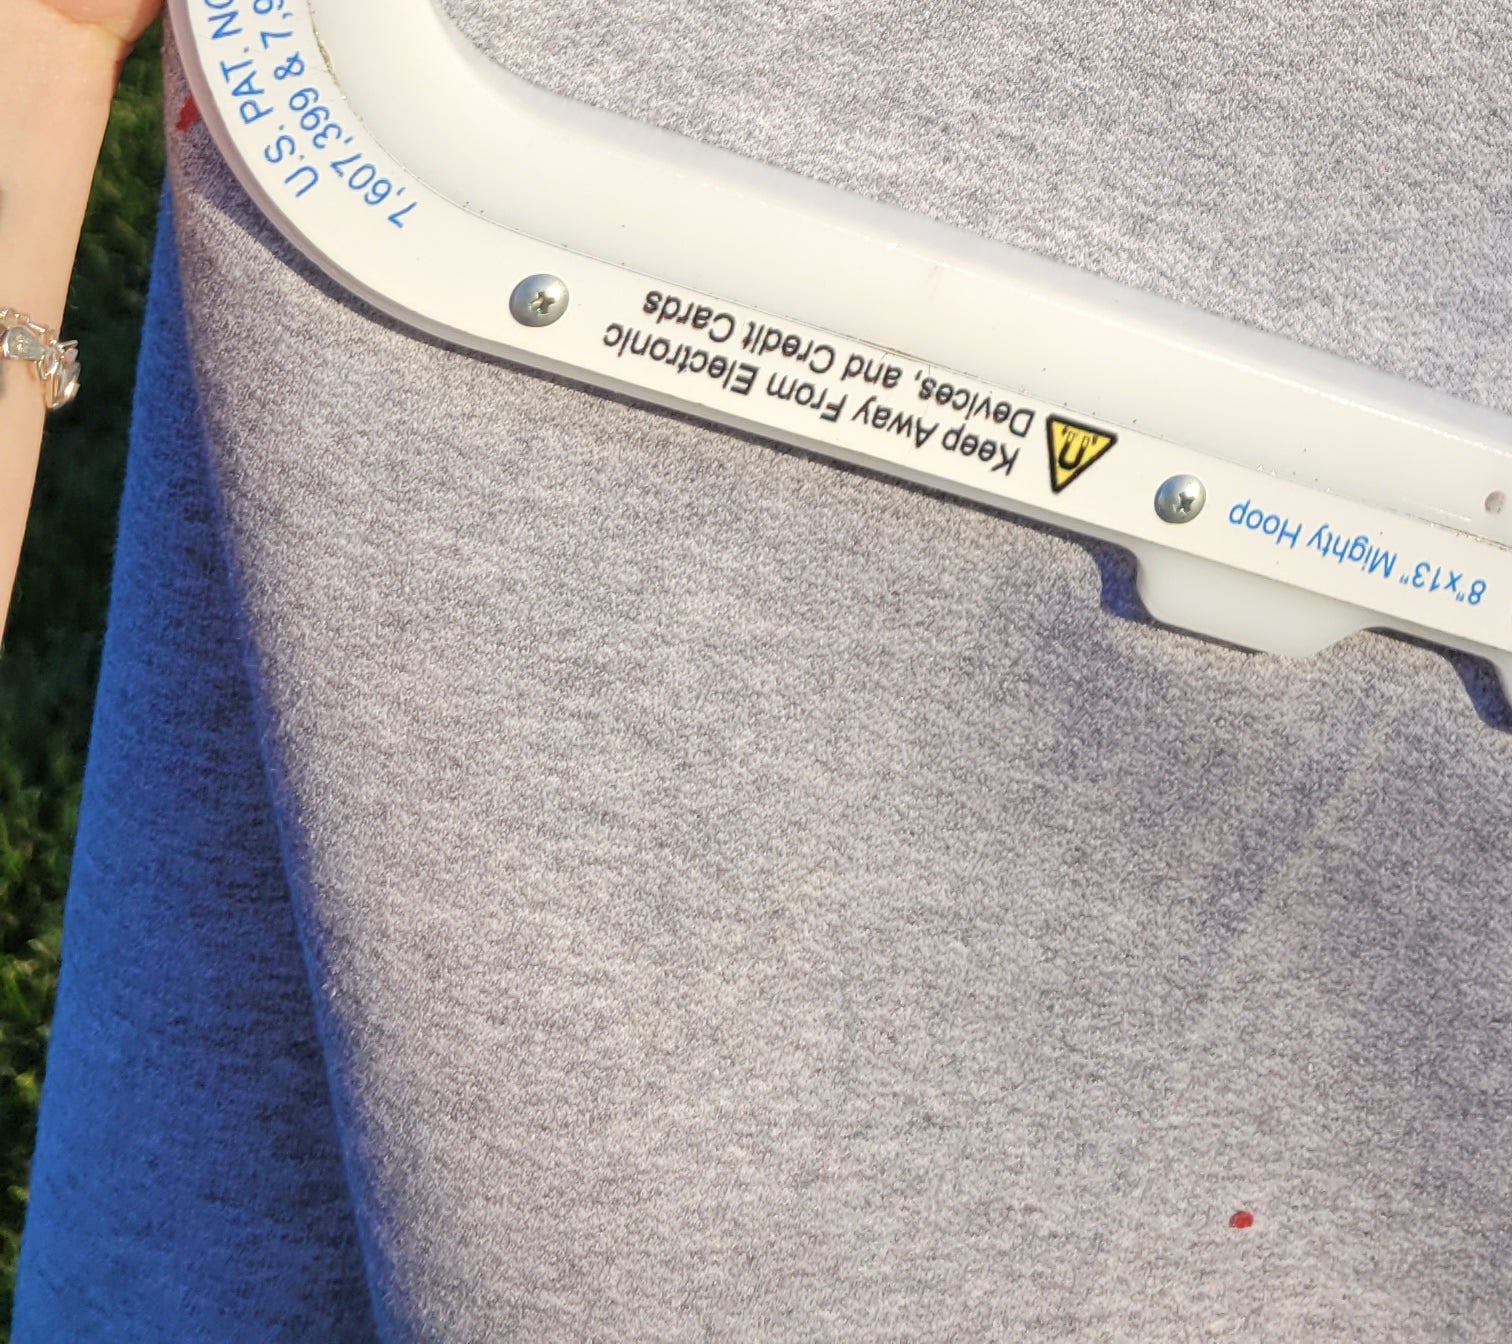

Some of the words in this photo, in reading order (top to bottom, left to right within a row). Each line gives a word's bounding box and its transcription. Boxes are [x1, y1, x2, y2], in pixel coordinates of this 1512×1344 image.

[219, 46, 274, 125] PAT.
[273, 51, 306, 81] &
[265, 124, 320, 198] U.S.
[289, 87, 419, 228] 7,607,399
[642, 290, 735, 344] Cards
[602, 322, 760, 396] Electronic
[741, 318, 835, 374] Credit
[843, 352, 902, 390] and
[766, 371, 848, 424] From
[852, 394, 940, 449] Away
[914, 371, 1036, 438] Devices,
[942, 426, 1020, 476] Keep
[1228, 499, 1303, 549] Hoop
[1306, 522, 1396, 580] Mighty
[1399, 560, 1488, 606] 8"x13"
